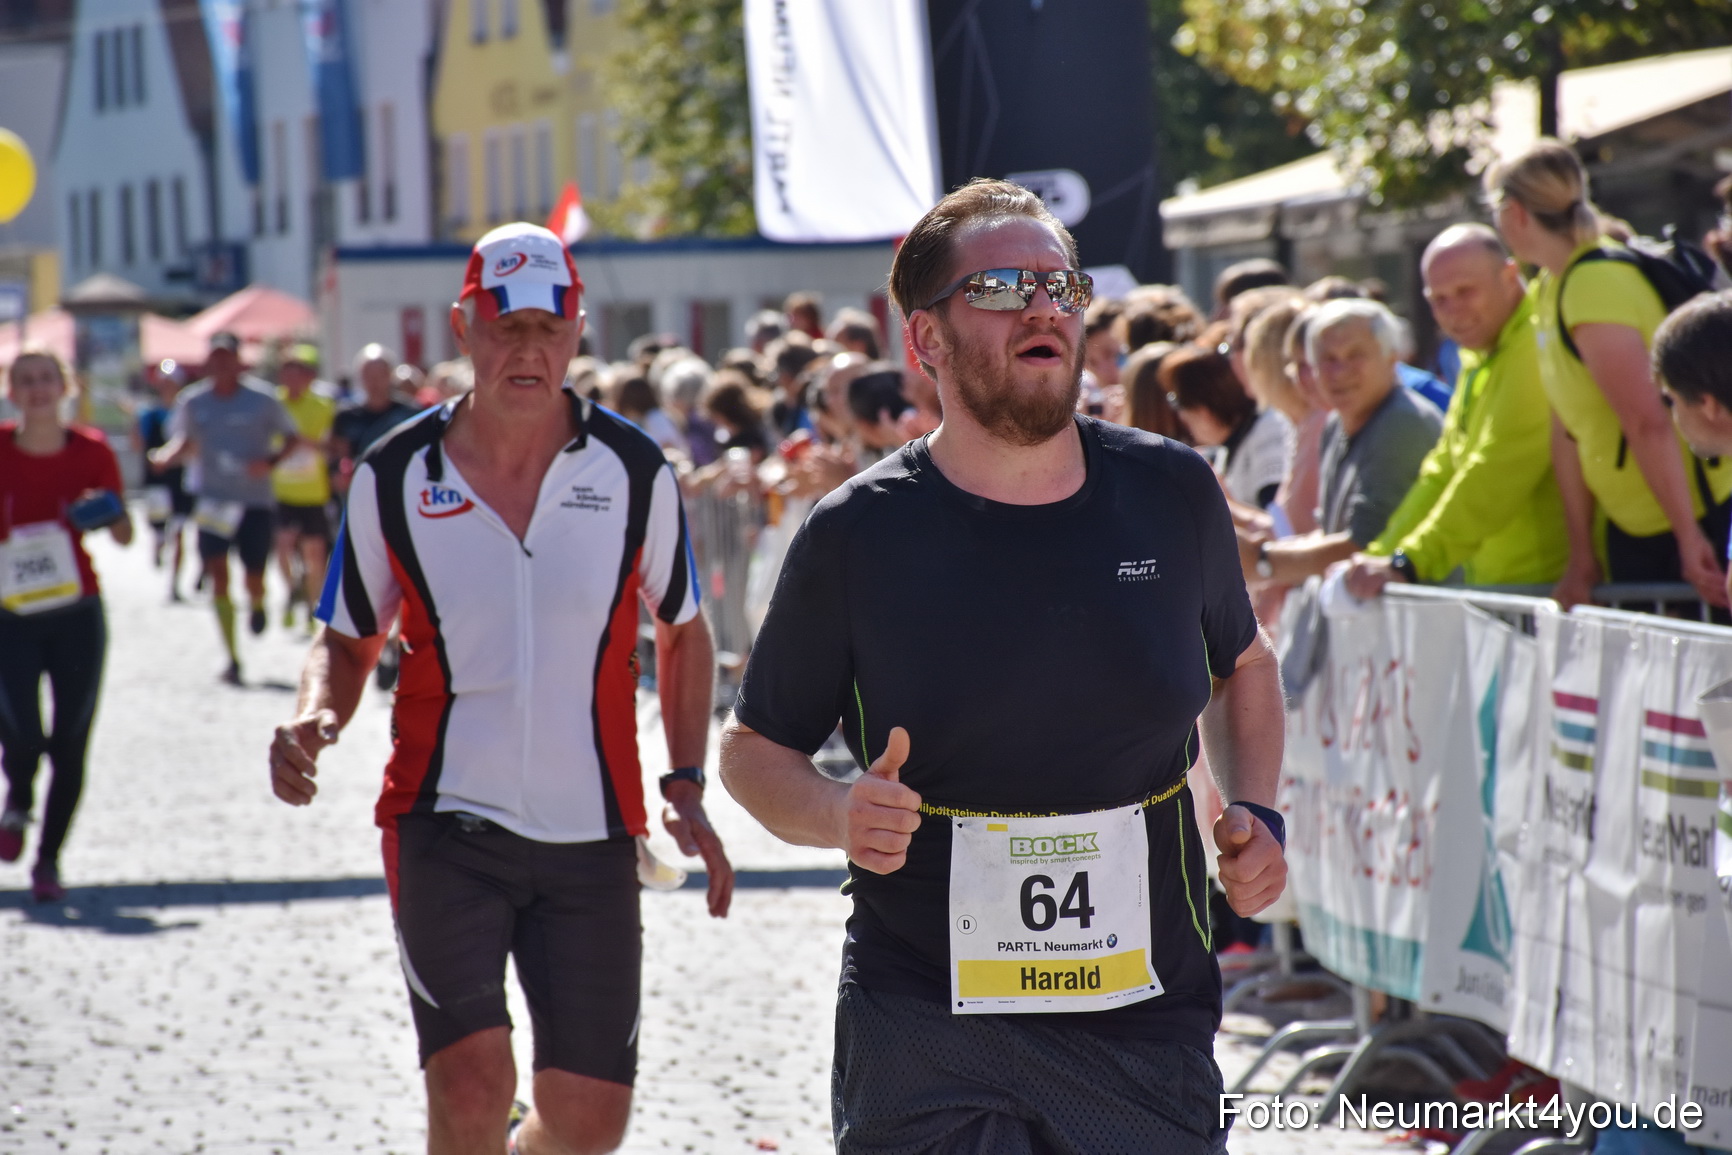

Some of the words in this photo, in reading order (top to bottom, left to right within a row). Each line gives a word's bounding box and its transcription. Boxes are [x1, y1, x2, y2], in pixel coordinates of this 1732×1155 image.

[420, 485, 463, 507] tkn
[1151, 783, 1182, 805] Duathlon
[1010, 832, 1100, 857] BOCK
[1010, 857, 1038, 865] inspired
[1050, 856, 1070, 864] smart
[1072, 853, 1101, 862] concepts
[1020, 871, 1095, 931] 64
[963, 920, 970, 930] D
[997, 942, 1041, 952] PARTL
[1044, 939, 1103, 951] Neumarkt
[1020, 965, 1101, 990] Harald
